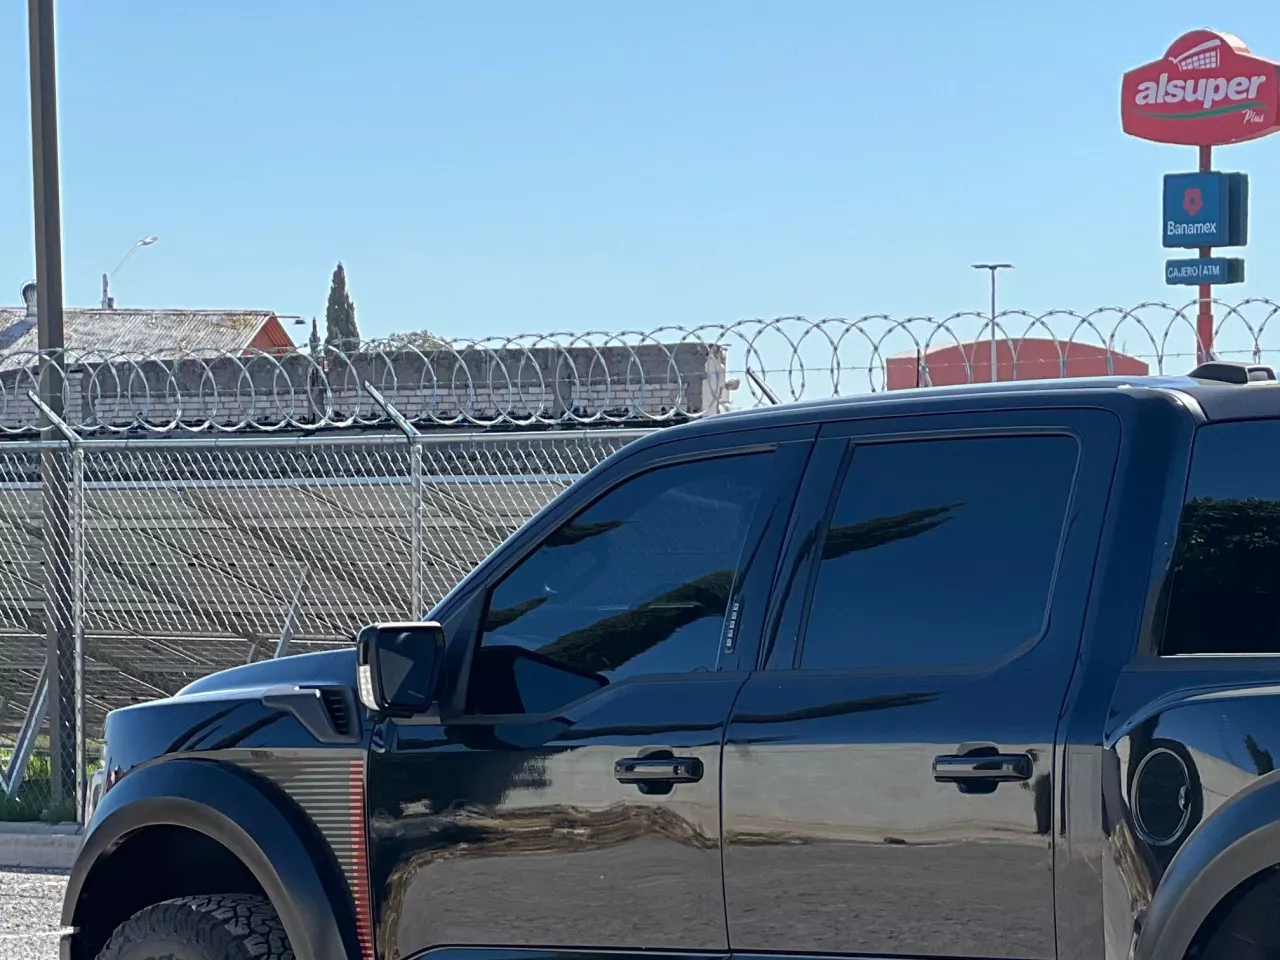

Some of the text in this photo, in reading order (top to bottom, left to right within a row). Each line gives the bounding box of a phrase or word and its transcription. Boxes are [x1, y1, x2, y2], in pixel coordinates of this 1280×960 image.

[1135, 73, 1267, 109] alsuper
[1241, 109, 1264, 124] Plus
[1167, 221, 1217, 235] Banamex
